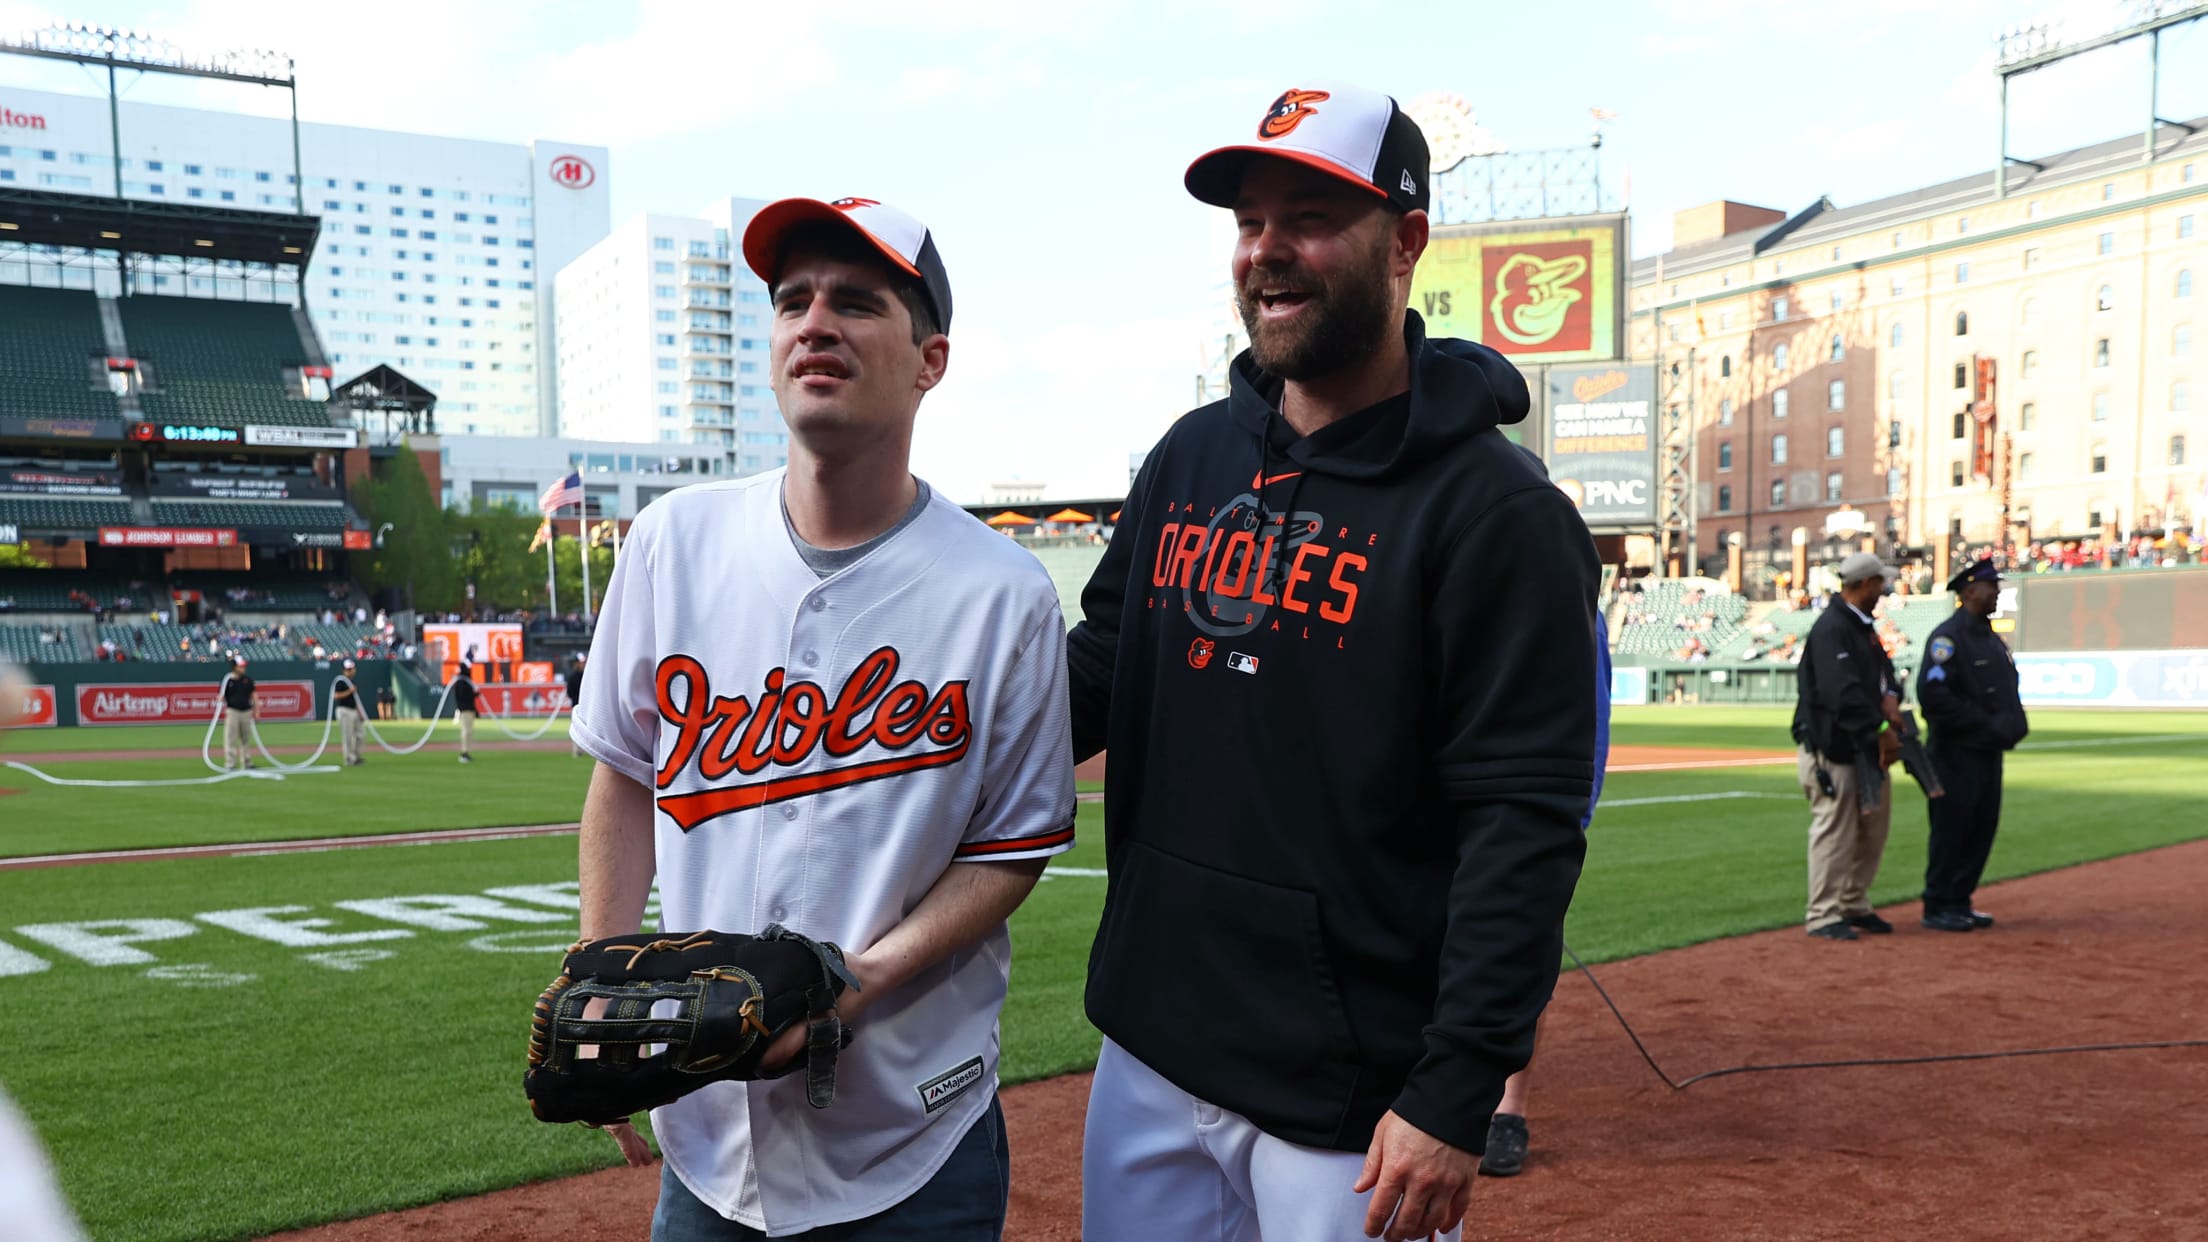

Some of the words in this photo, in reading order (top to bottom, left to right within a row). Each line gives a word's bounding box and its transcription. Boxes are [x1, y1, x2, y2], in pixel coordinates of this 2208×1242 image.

[1424, 291, 1451, 316] VS
[1555, 420, 1587, 437] CAN
[1632, 418, 1646, 434] A
[1585, 480, 1647, 505] PNC
[1153, 522, 1368, 625] ORIOLES
[94, 692, 168, 714] Airtemp
[655, 645, 972, 790] Orioles
[942, 1068, 979, 1091] Majestic
